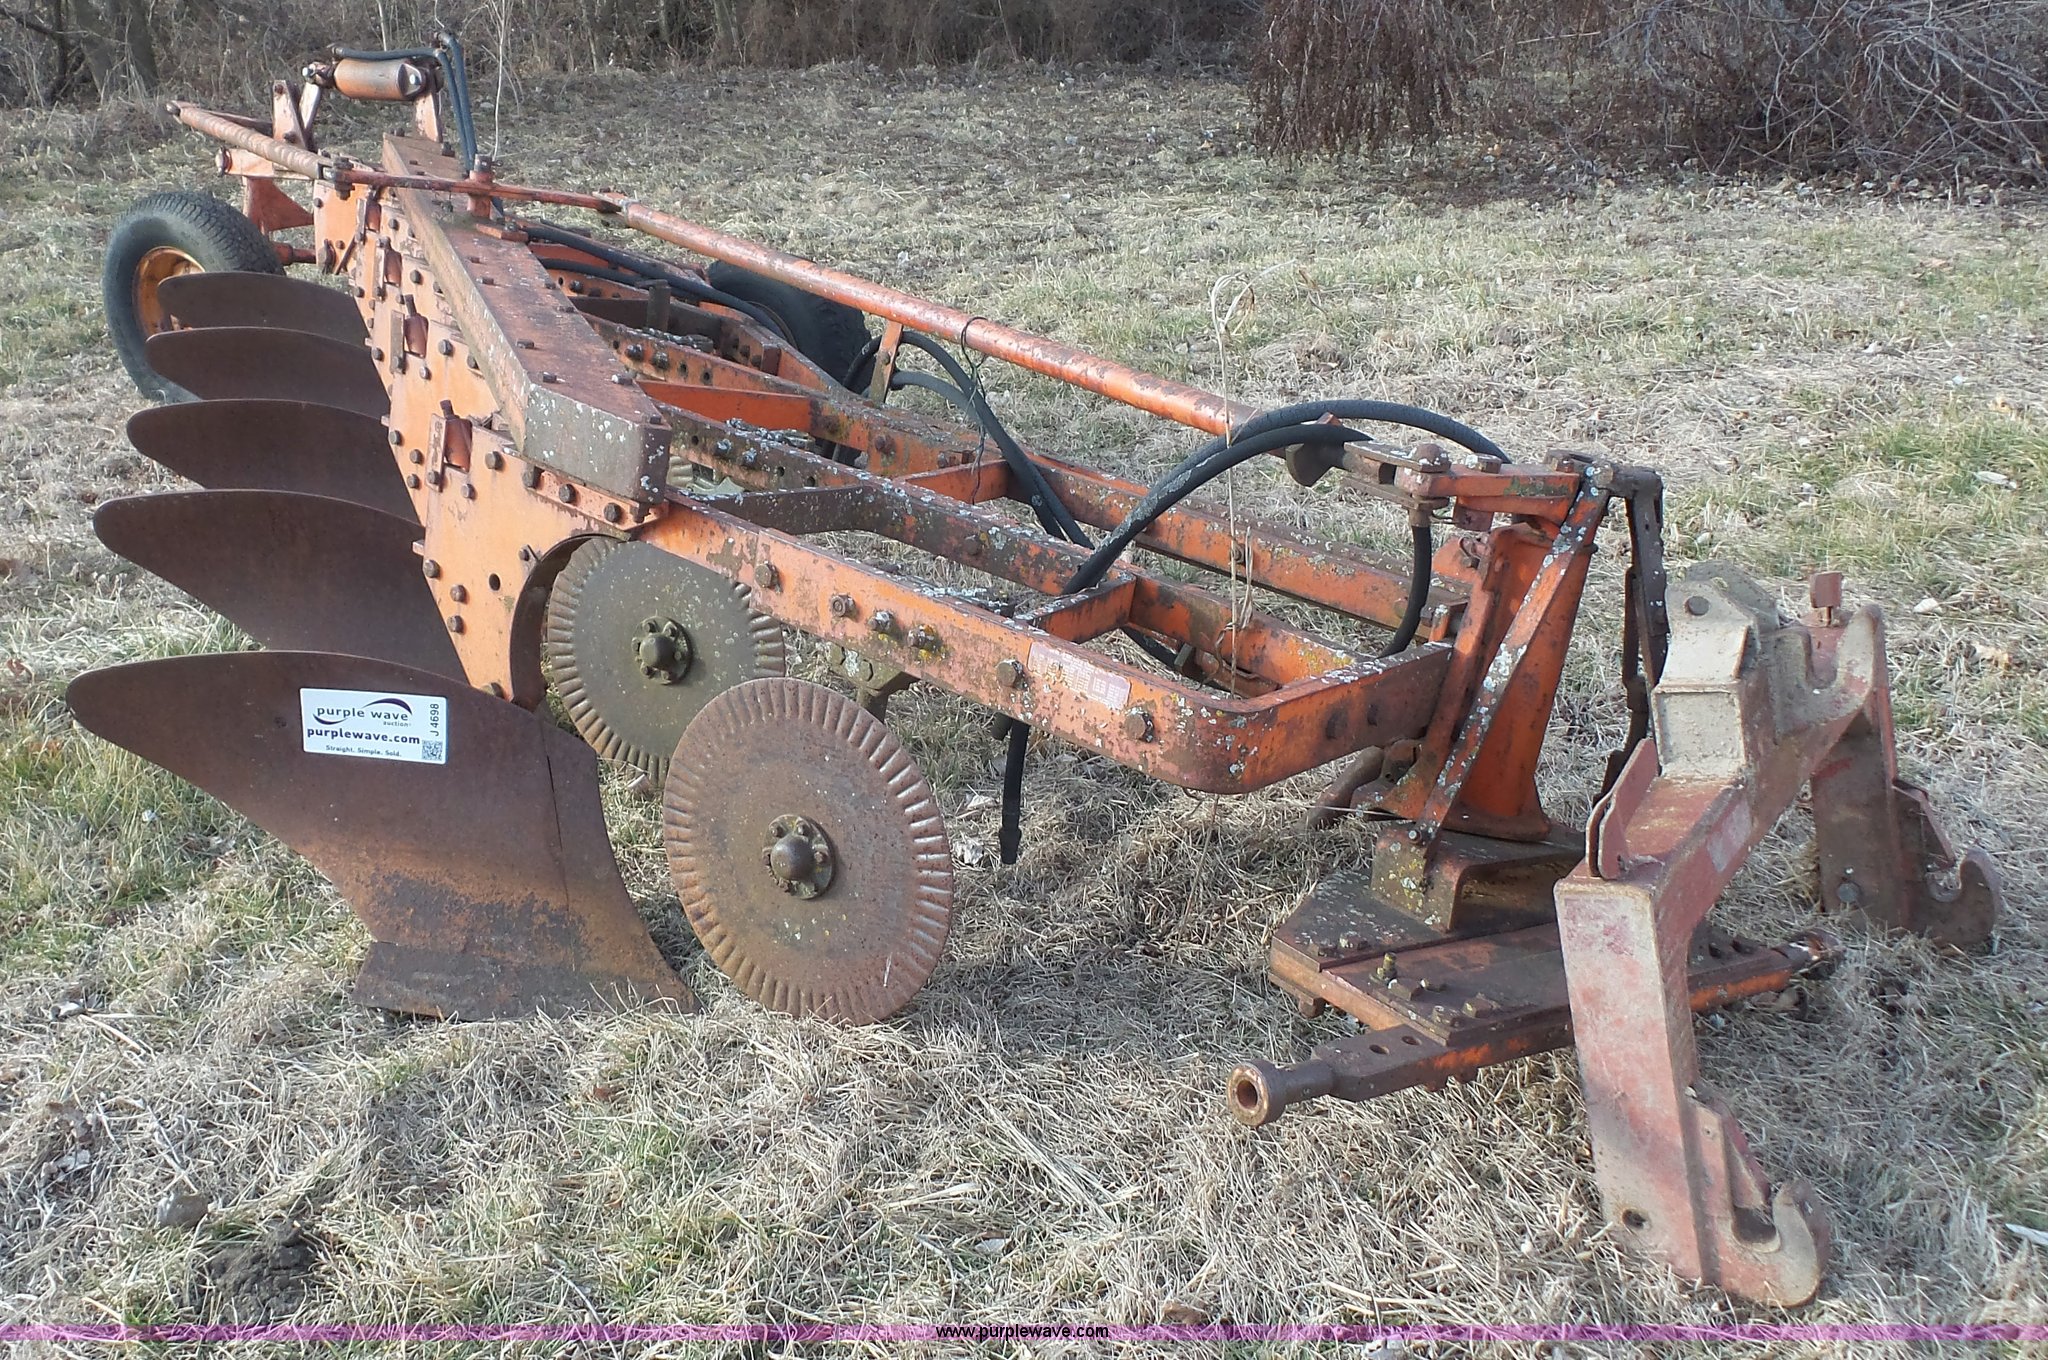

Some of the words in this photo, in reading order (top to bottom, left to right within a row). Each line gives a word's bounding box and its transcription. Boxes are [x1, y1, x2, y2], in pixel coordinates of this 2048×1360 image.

[317, 707, 365, 718] purple
[371, 710, 408, 721] wave
[307, 728, 420, 744] purplewave.com
[325, 744, 355, 753] Straight.
[357, 747, 383, 755] Simple.
